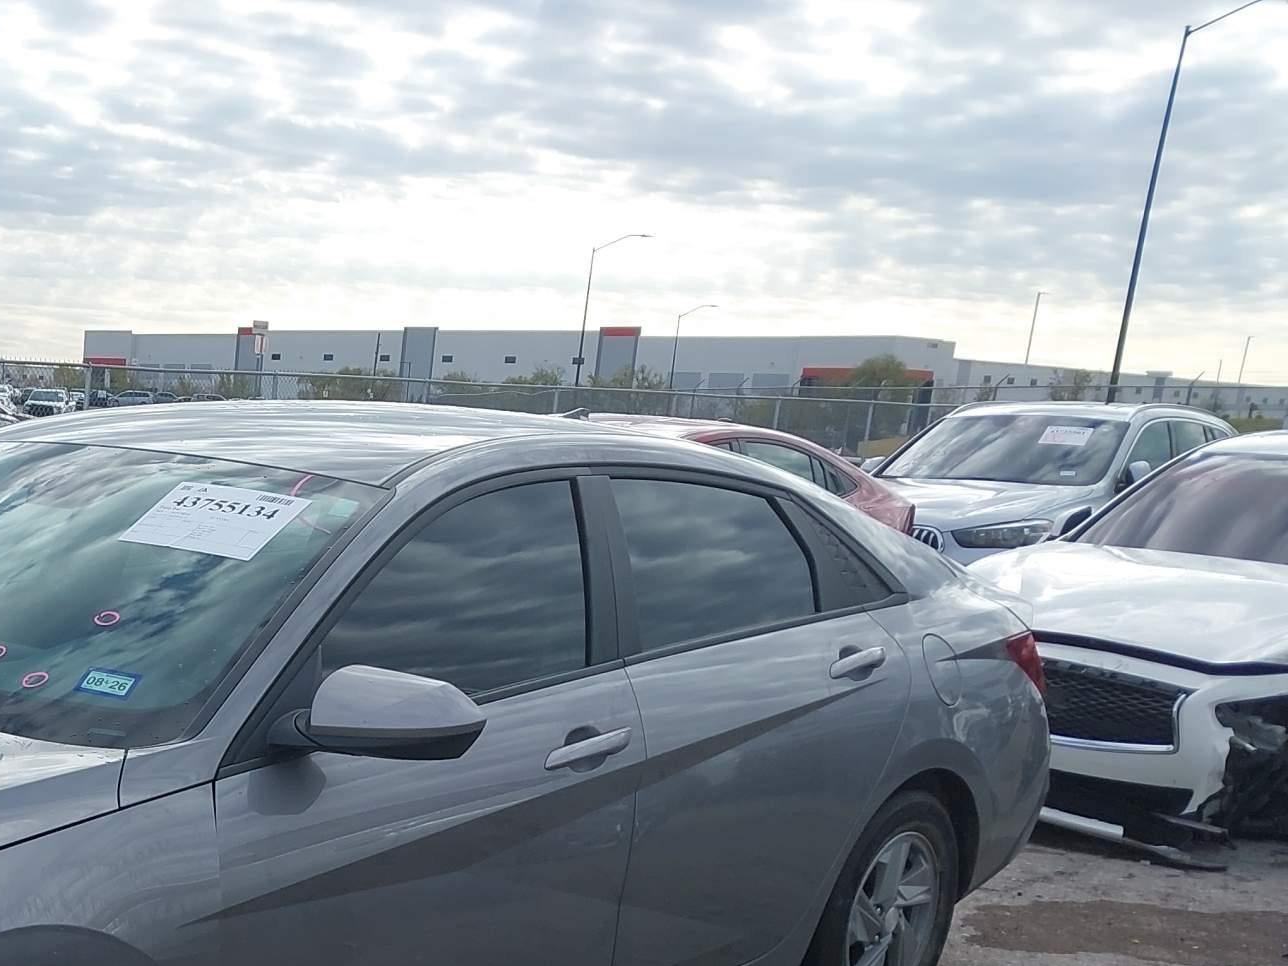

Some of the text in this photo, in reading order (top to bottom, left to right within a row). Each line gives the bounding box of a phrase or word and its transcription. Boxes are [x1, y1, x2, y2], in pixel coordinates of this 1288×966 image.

[173, 495, 280, 520] 43755134
[86, 676, 128, 692] 08 26
